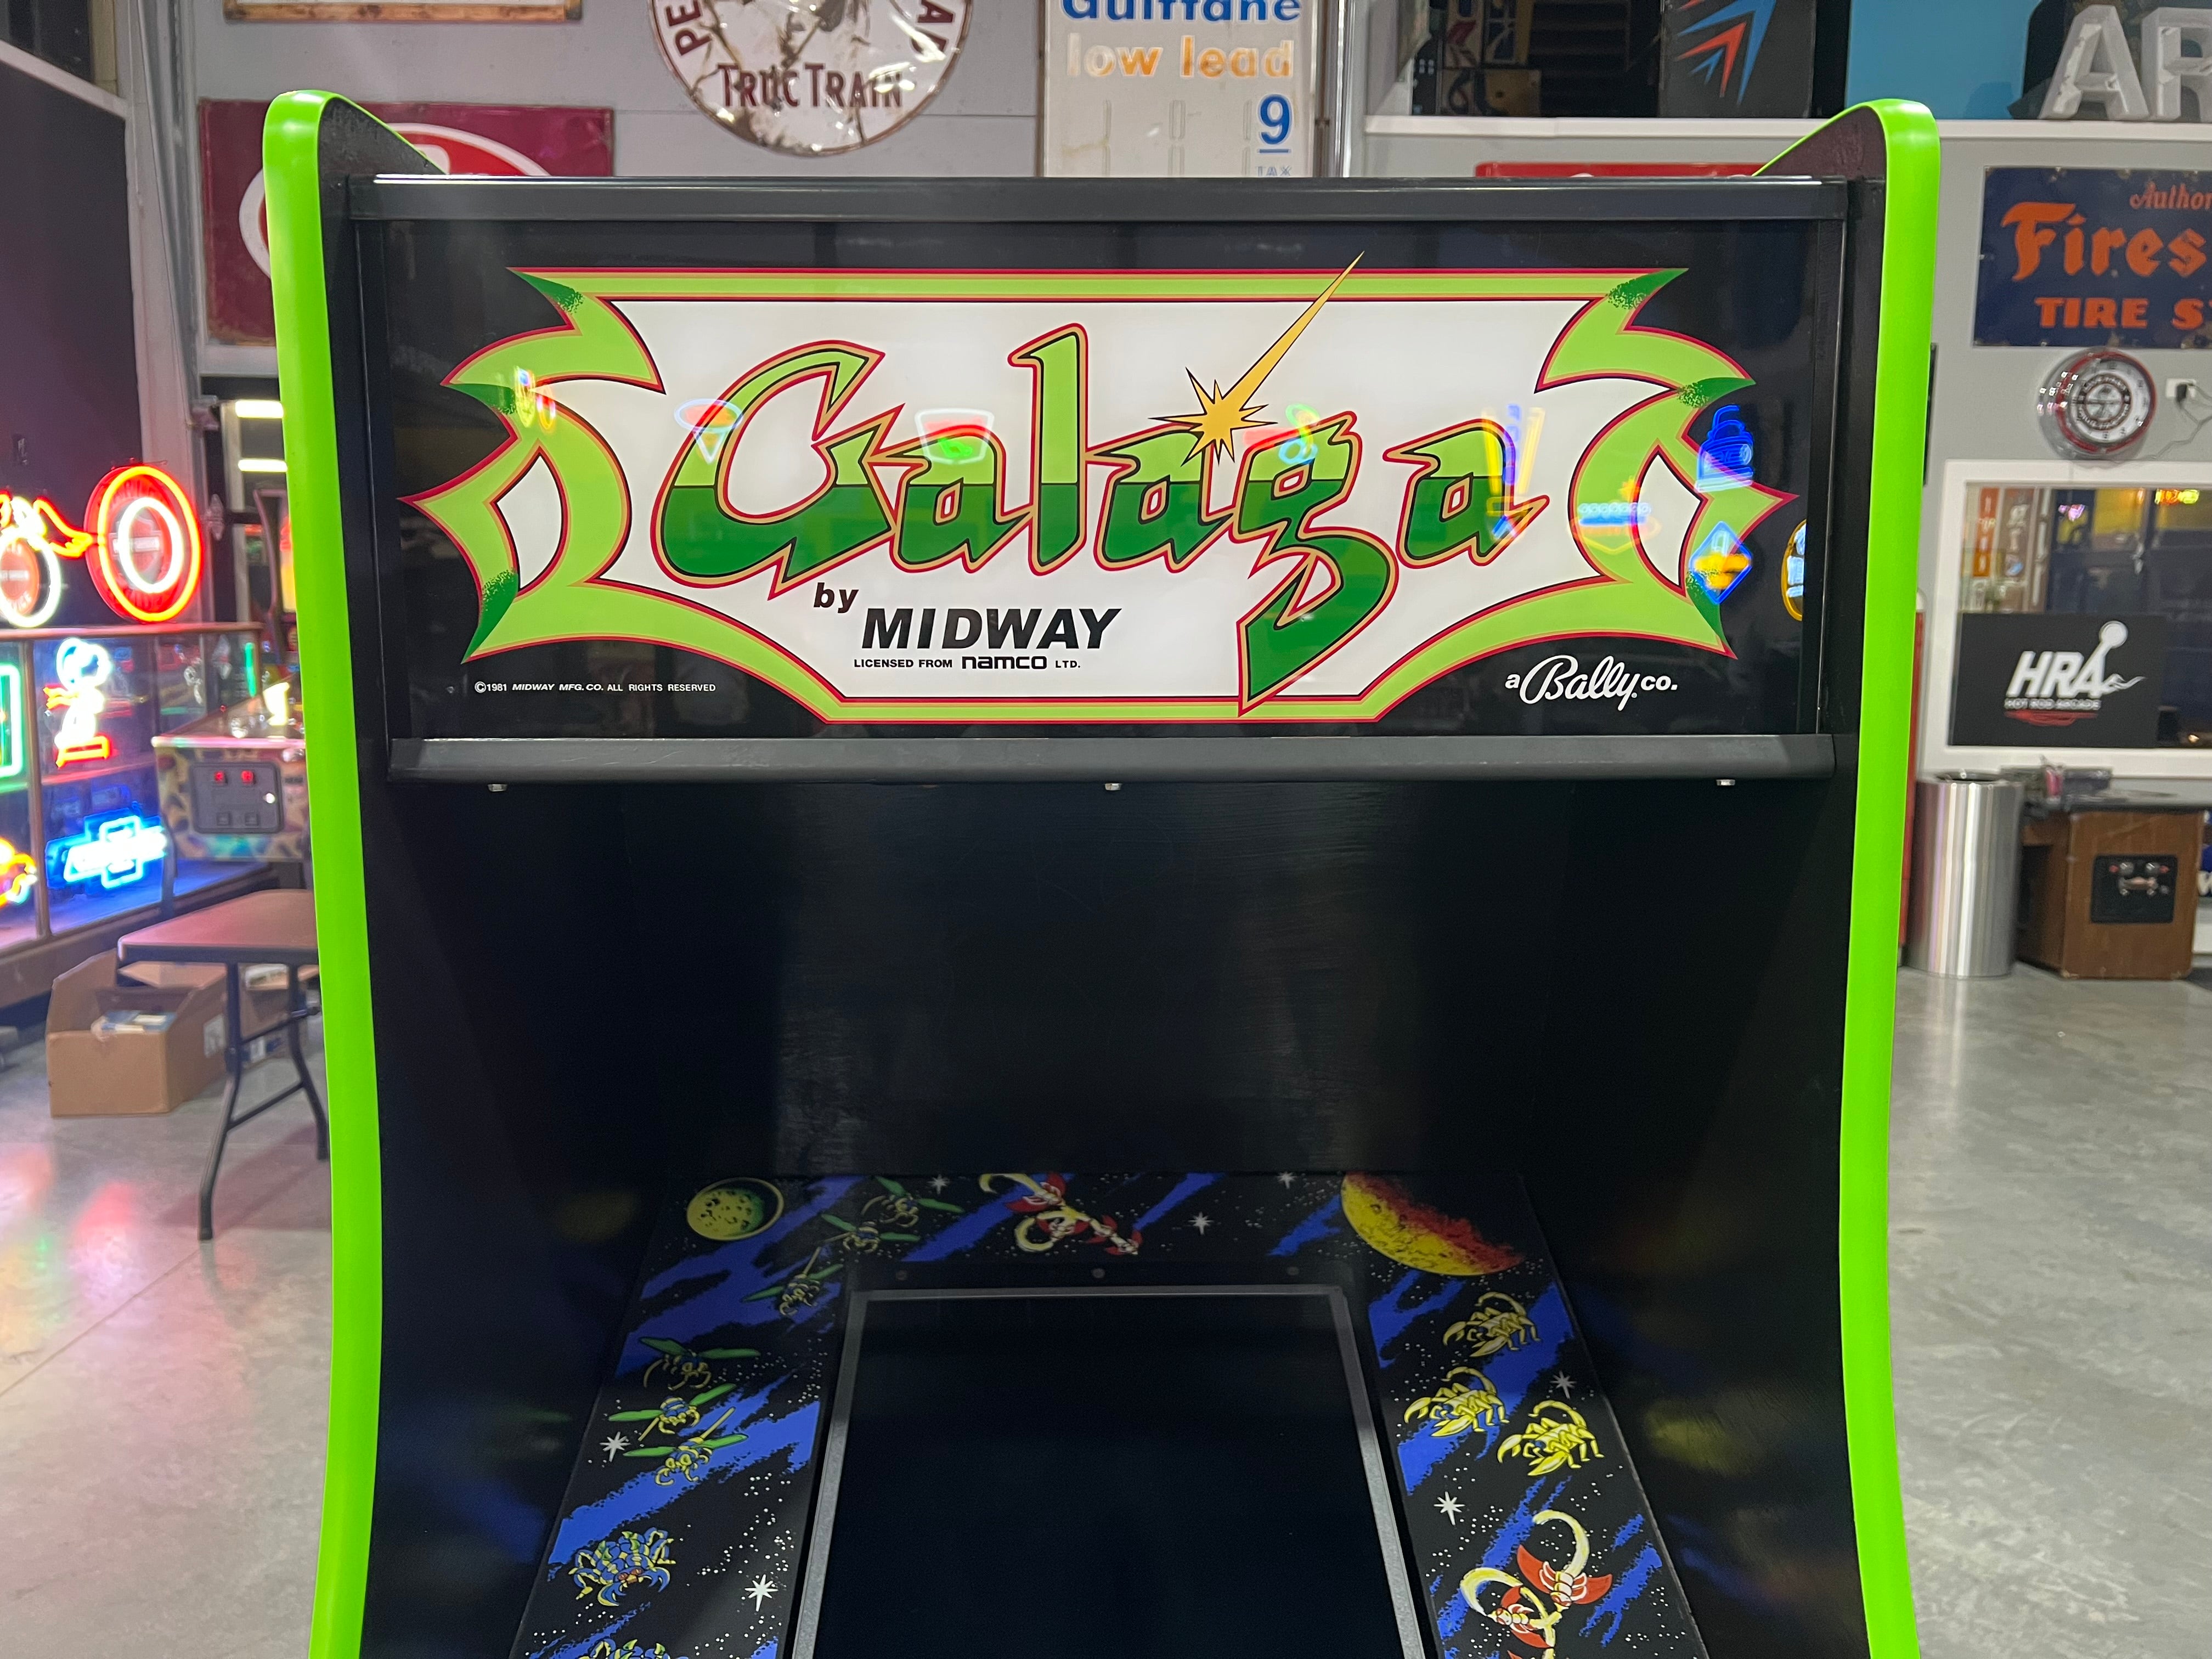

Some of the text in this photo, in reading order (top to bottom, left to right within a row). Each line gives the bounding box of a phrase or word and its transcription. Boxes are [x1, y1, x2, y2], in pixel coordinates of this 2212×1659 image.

[1067, 33, 1294, 78] low lead
[2037, 4, 2212, 122] AR
[1258, 94, 1293, 145] 9
[1257, 166, 1291, 177] TAX
[2000, 201, 2207, 281] Fires
[2034, 297, 2212, 329] TIRE S
[650, 323, 1548, 718] Galaga
[813, 582, 859, 613] by
[861, 608, 1122, 650] MIDWAY
[854, 656, 1081, 670] LICENSED FROM namco LTD.
[1505, 654, 1678, 711] a Bally co.
[2006, 643, 2112, 699] HRA
[607, 684, 623, 692] ALL
[629, 684, 663, 692] RIGHTS
[668, 684, 716, 692] RESERVED
